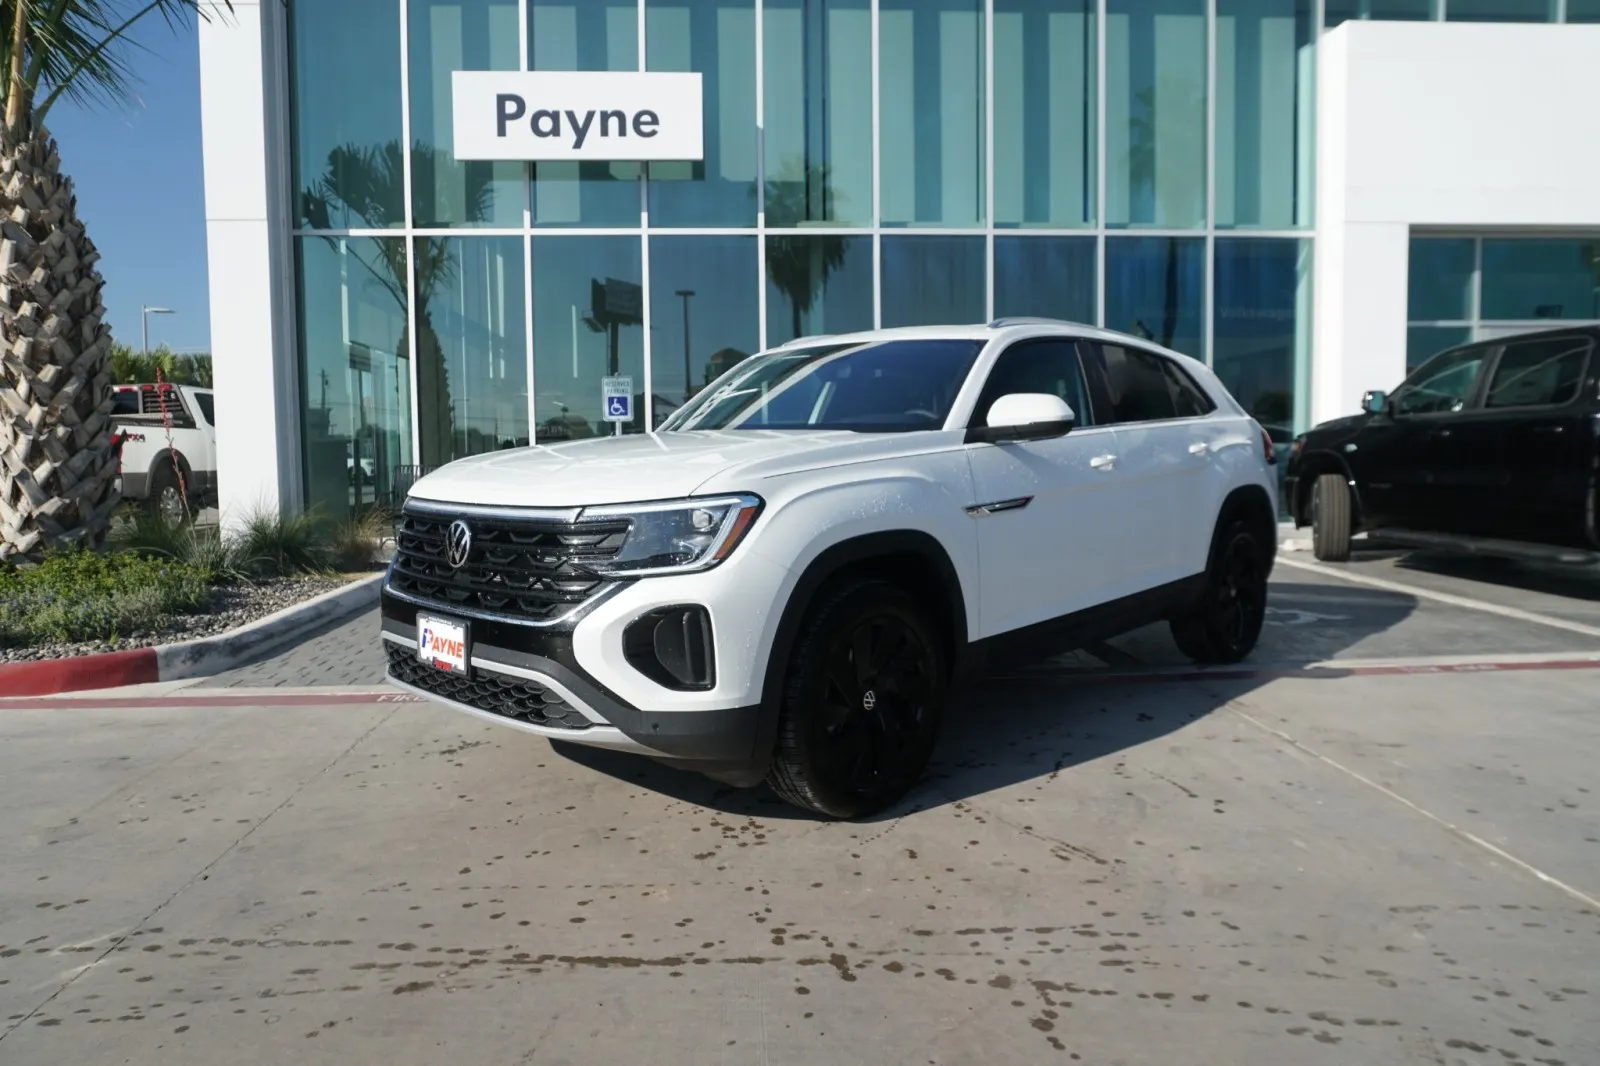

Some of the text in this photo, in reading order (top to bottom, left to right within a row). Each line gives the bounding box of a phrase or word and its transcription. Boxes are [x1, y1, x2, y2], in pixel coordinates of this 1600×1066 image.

[496, 93, 660, 149] Payne
[1219, 306, 1293, 321] Volkswage
[422, 628, 464, 658] PAYNE
